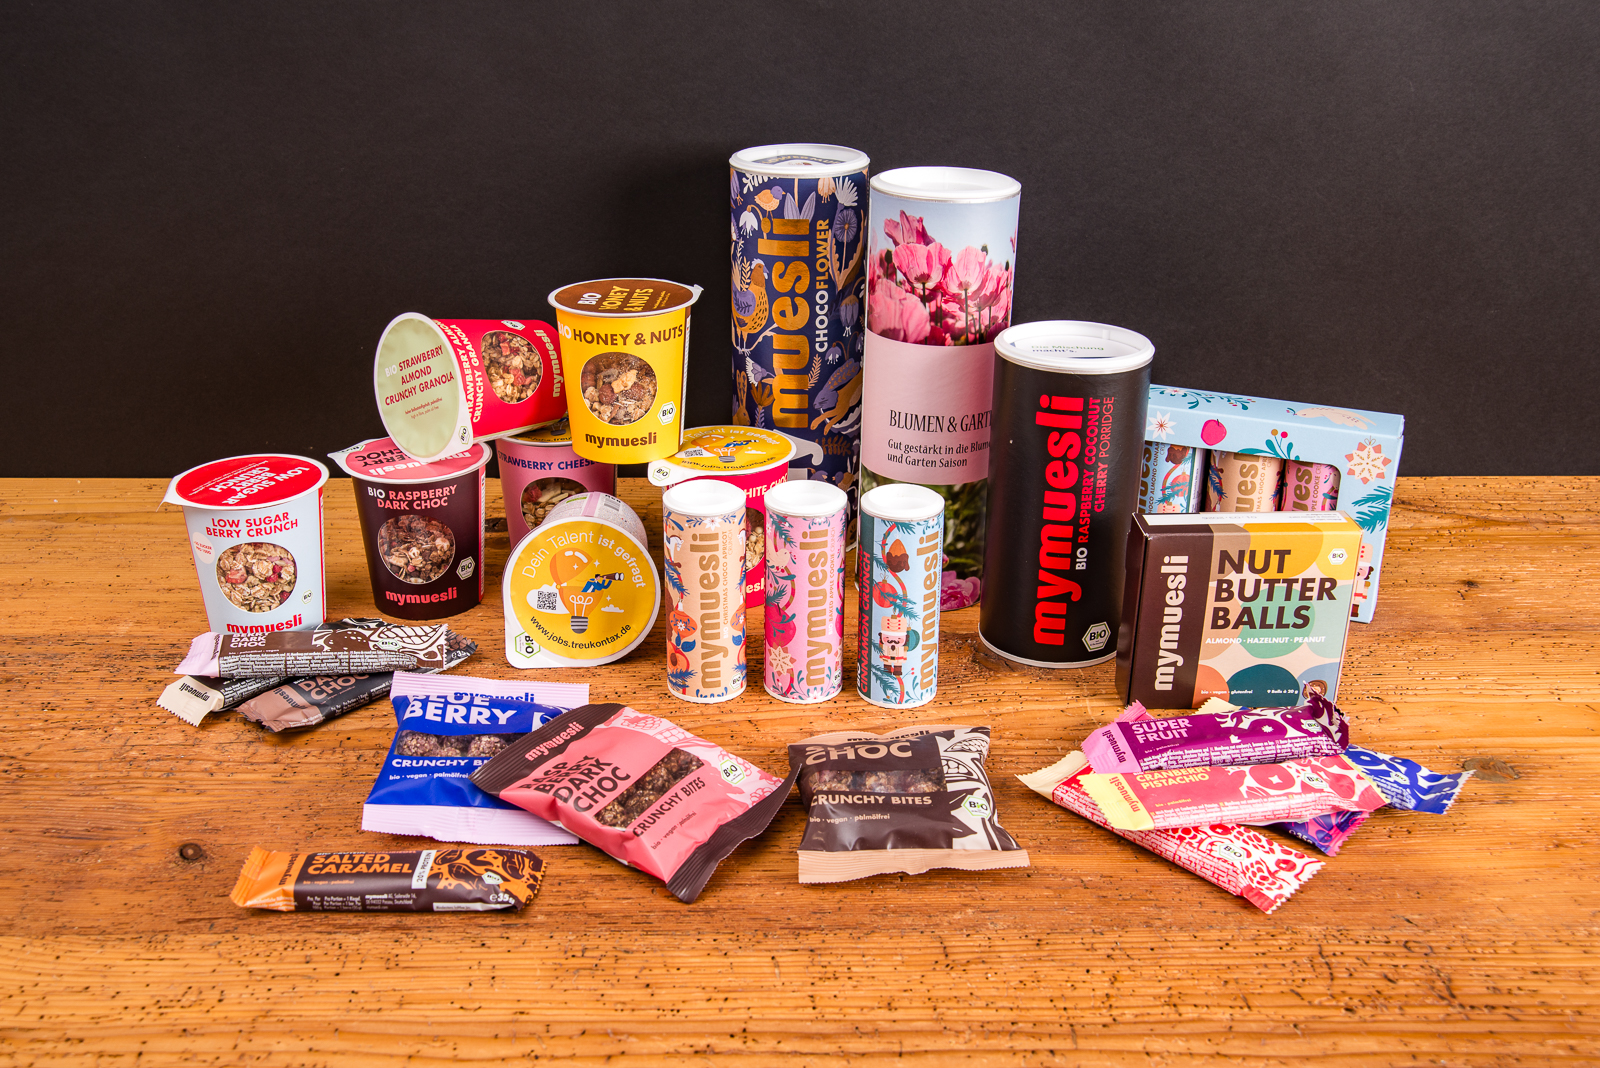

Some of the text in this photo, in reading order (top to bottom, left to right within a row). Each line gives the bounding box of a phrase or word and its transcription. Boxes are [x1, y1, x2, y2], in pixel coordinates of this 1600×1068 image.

[815, 218, 830, 353] CHOCOFLOWER
[578, 292, 602, 305] BIO
[598, 286, 631, 310] HONEY
[630, 288, 654, 308] NUTS
[558, 321, 683, 346] BIO HONEY & NUTS
[385, 345, 444, 377] BIO STRAWBERRY
[534, 329, 564, 398] mymuesli
[401, 366, 432, 386] ALMOND
[450, 324, 484, 423] CRUNCHY GRANOLA
[385, 386, 416, 406] CRUNCHY
[419, 371, 454, 392] GRANOLA
[890, 409, 945, 432] BLUMEN
[947, 416, 958, 432] &
[585, 432, 657, 449] mymuesli
[888, 438, 902, 450] Gut
[904, 442, 942, 454] gestärkt
[945, 446, 954, 454] in
[956, 444, 968, 454] die
[498, 450, 554, 470] STRAWBERRY
[888, 453, 968, 468] und Garten Saison
[1094, 396, 1114, 513] CHERRY PORRIDGE
[209, 466, 270, 493] CRUNCH
[231, 472, 277, 492] BERRY
[274, 466, 310, 480] LOW
[1076, 398, 1100, 570] BIO RASPBERRY COCONUT
[222, 478, 276, 504] SUGAR
[368, 484, 458, 500] BIO RASPBERRY
[377, 497, 448, 510] DARK CHOC
[206, 518, 298, 538] BERRY CRUNCH
[212, 512, 289, 528] LOW SUGAR
[1034, 394, 1084, 646] mymuesli
[522, 530, 646, 588] Dein Talent ist gefragt
[1218, 550, 1291, 574] NUT
[386, 587, 458, 606] mymuesli
[1214, 578, 1338, 603] BUTTER
[690, 532, 728, 689] mymuesli
[800, 528, 832, 686] mymuesli
[916, 530, 940, 691] mymuesli
[1211, 606, 1310, 630] BALLS
[226, 614, 302, 634] mymuesli
[530, 616, 632, 649] www.jobs.treukontax.de
[860, 552, 871, 692] CINNAMON CRUNCH
[1154, 556, 1189, 691] mymuesli
[179, 682, 210, 701] mymuesli
[403, 700, 518, 725] BERRY
[1132, 718, 1192, 734] SUPER
[1136, 728, 1188, 744] FRUIT
[525, 722, 584, 761] mymuesli
[1102, 730, 1126, 763] mymuesli
[392, 758, 468, 768] CRUNCHY
[806, 742, 912, 766] CHOC
[552, 758, 614, 804] DARK
[1136, 766, 1211, 782] CRANBERRY
[1141, 773, 1210, 790] PISTACHIO
[573, 766, 631, 813] CHOC
[811, 794, 932, 806] CRUNCHY BITES
[1109, 776, 1140, 812] mymuesli
[632, 776, 706, 837] CRUNCHY BITES
[855, 814, 890, 822] palmölfrei
[651, 841, 661, 850] bio
[664, 825, 678, 838] vegan
[308, 863, 412, 874] CARAMEL
[312, 854, 391, 864] SALTED
[416, 870, 426, 882] 20%
